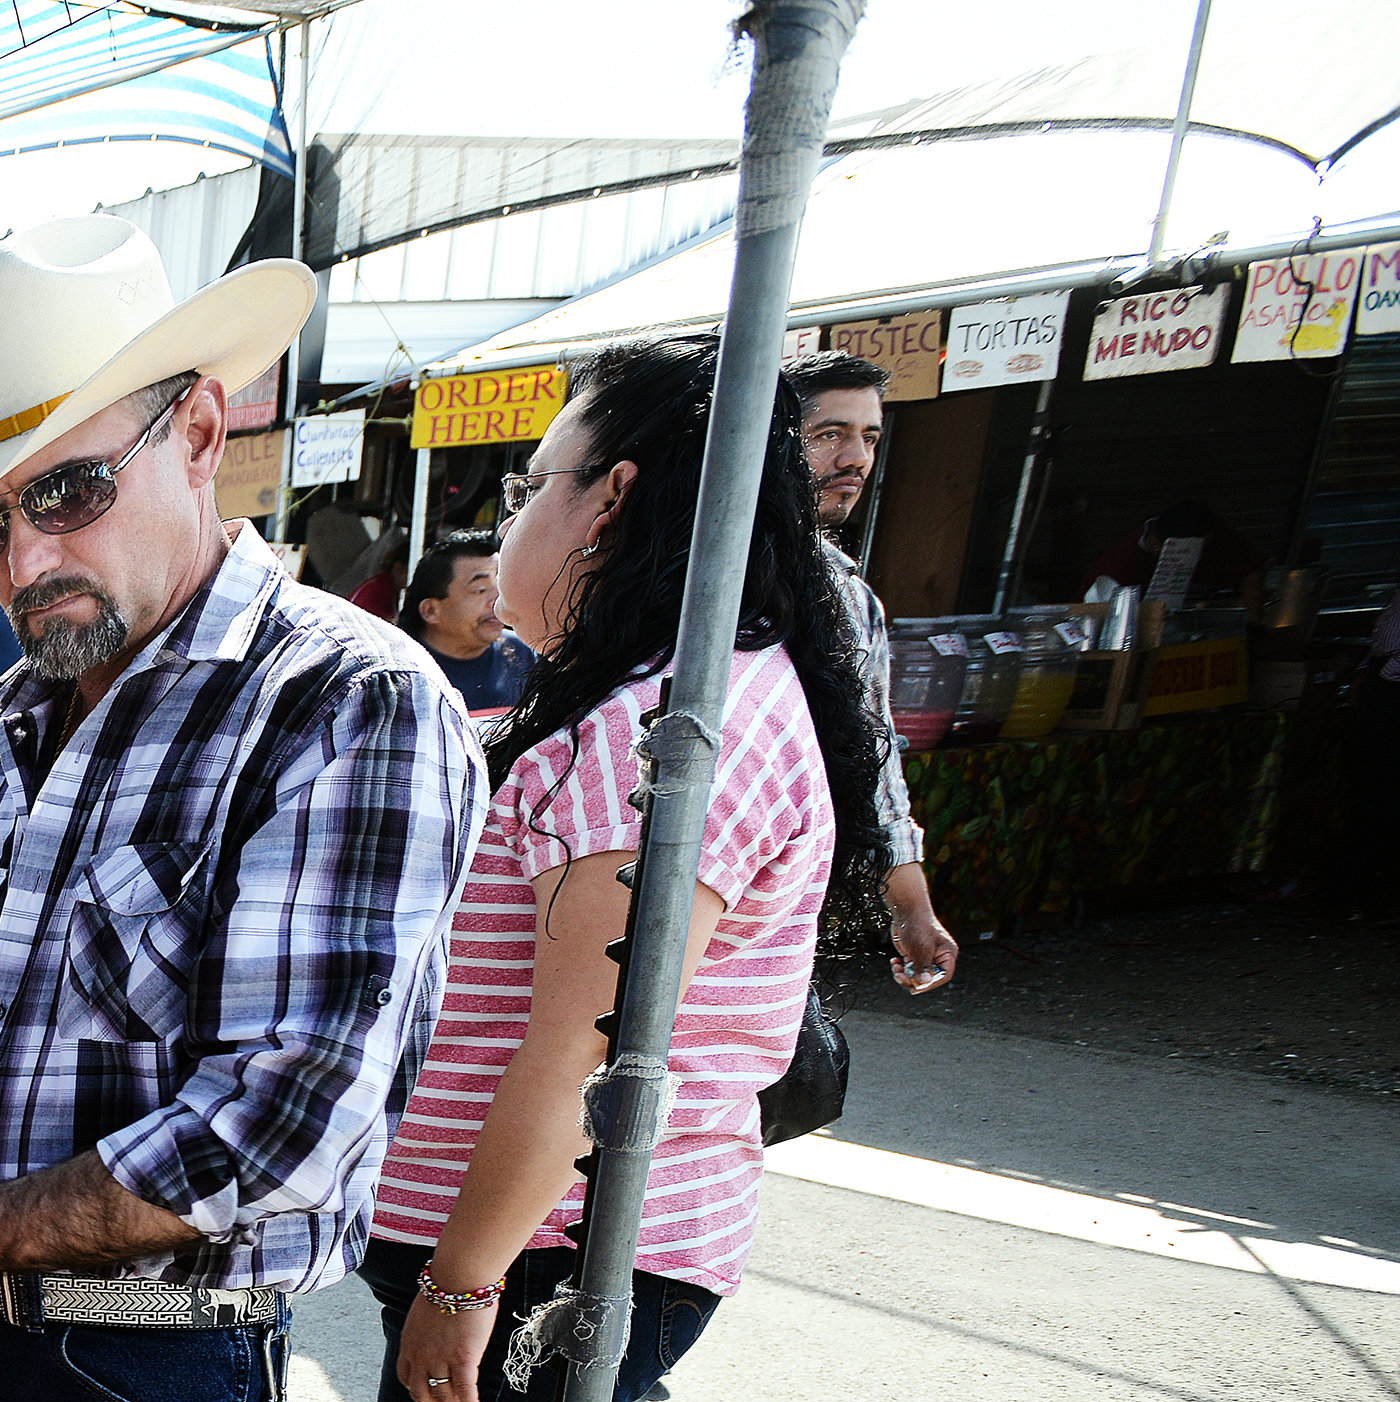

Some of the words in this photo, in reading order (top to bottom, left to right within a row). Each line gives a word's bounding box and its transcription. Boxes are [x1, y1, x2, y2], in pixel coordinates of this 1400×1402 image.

[1250, 257, 1356, 303] POLLO
[1120, 293, 1189, 326] RICO
[1239, 301, 1327, 330] ASADO
[836, 321, 938, 358] BISTEC
[957, 314, 1057, 352] TORTAS
[1094, 325, 1211, 363] MENUDO
[420, 370, 556, 411] ORDER
[427, 407, 535, 444] HERE
